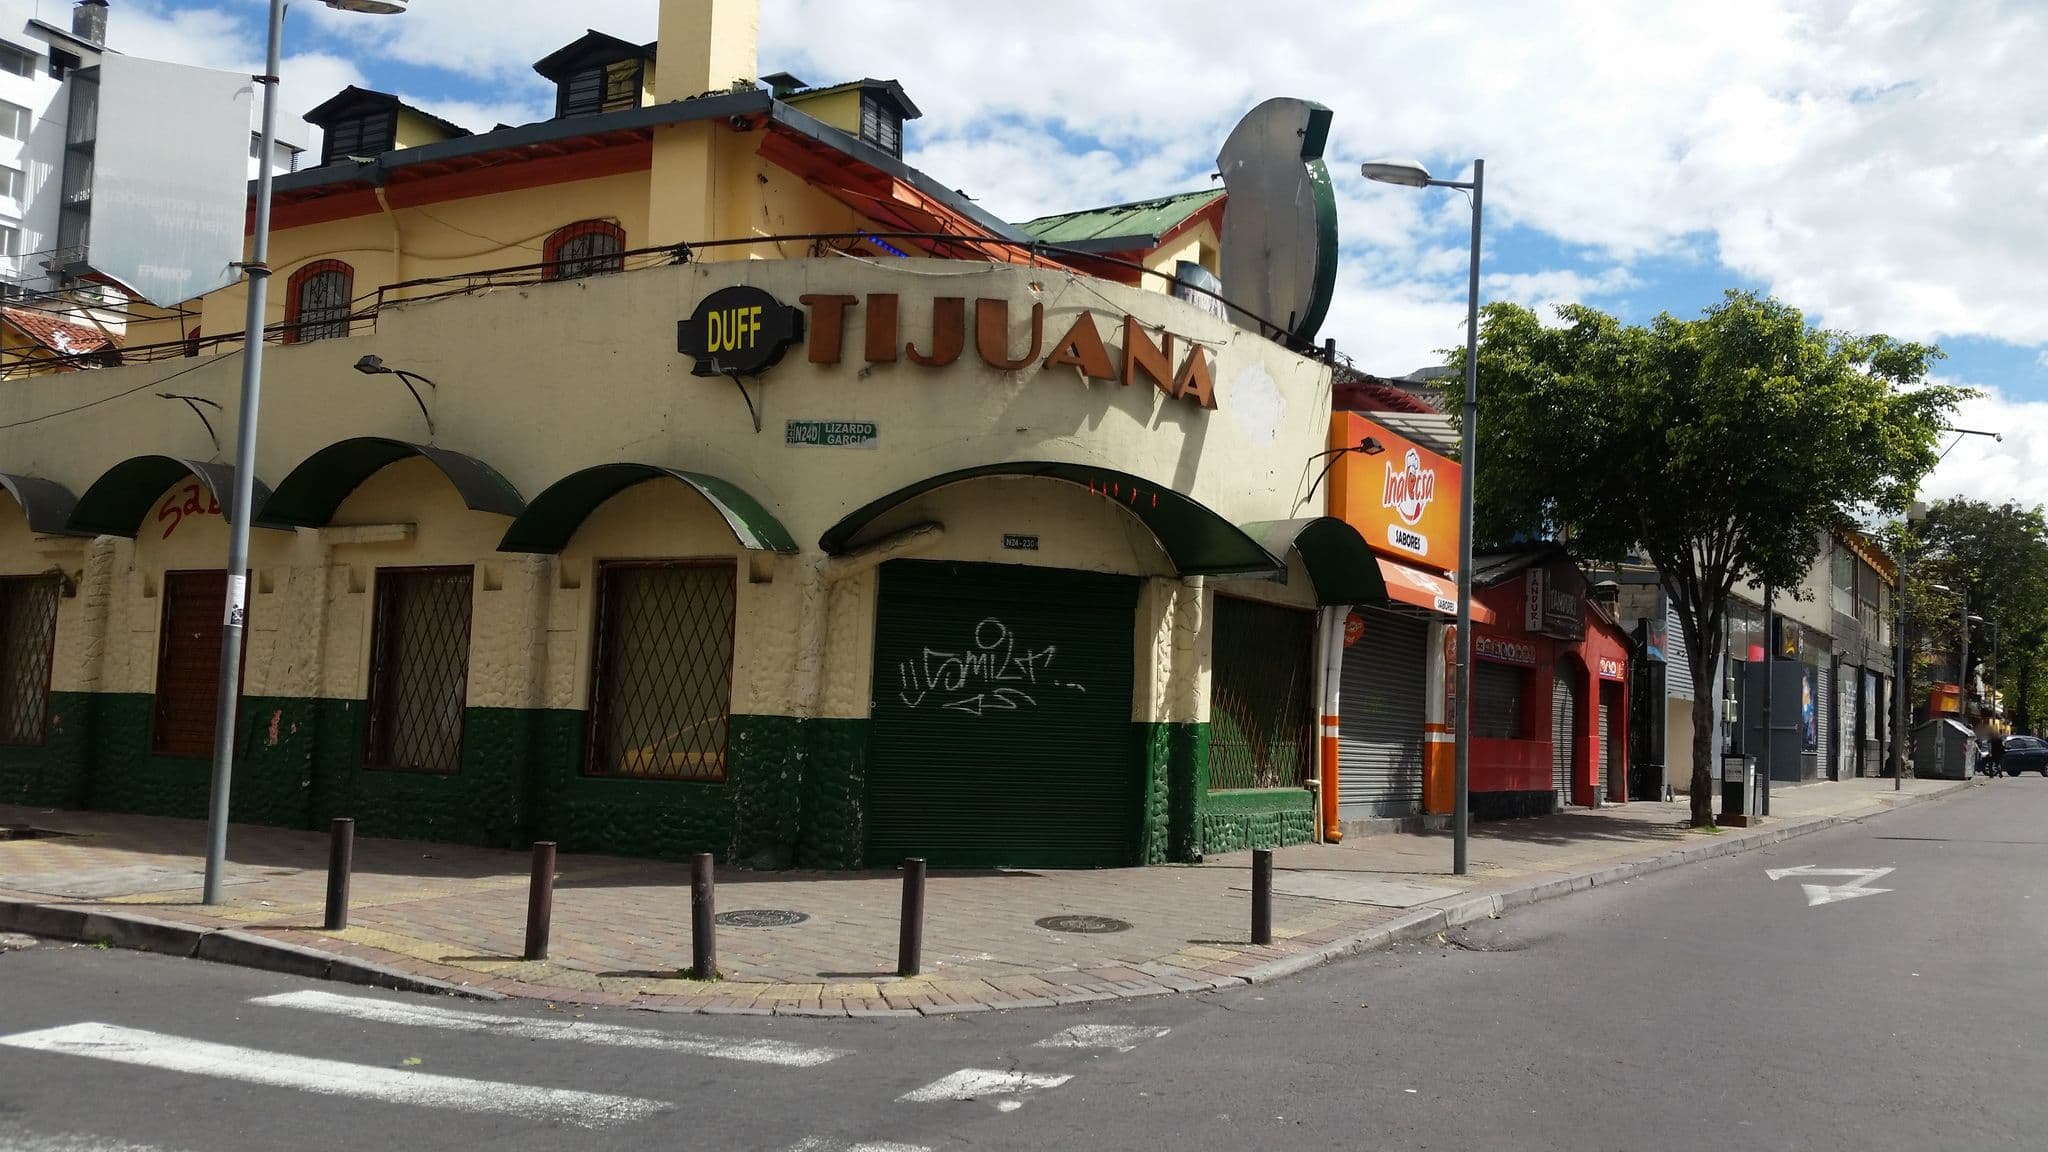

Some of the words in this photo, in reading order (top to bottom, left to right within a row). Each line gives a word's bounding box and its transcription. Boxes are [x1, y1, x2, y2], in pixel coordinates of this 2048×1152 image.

[708, 306, 761, 353] DUFF
[799, 293, 1218, 411] TIJUANA
[825, 423, 872, 434] LIZARDO
[1395, 529, 1421, 551] SABORES
